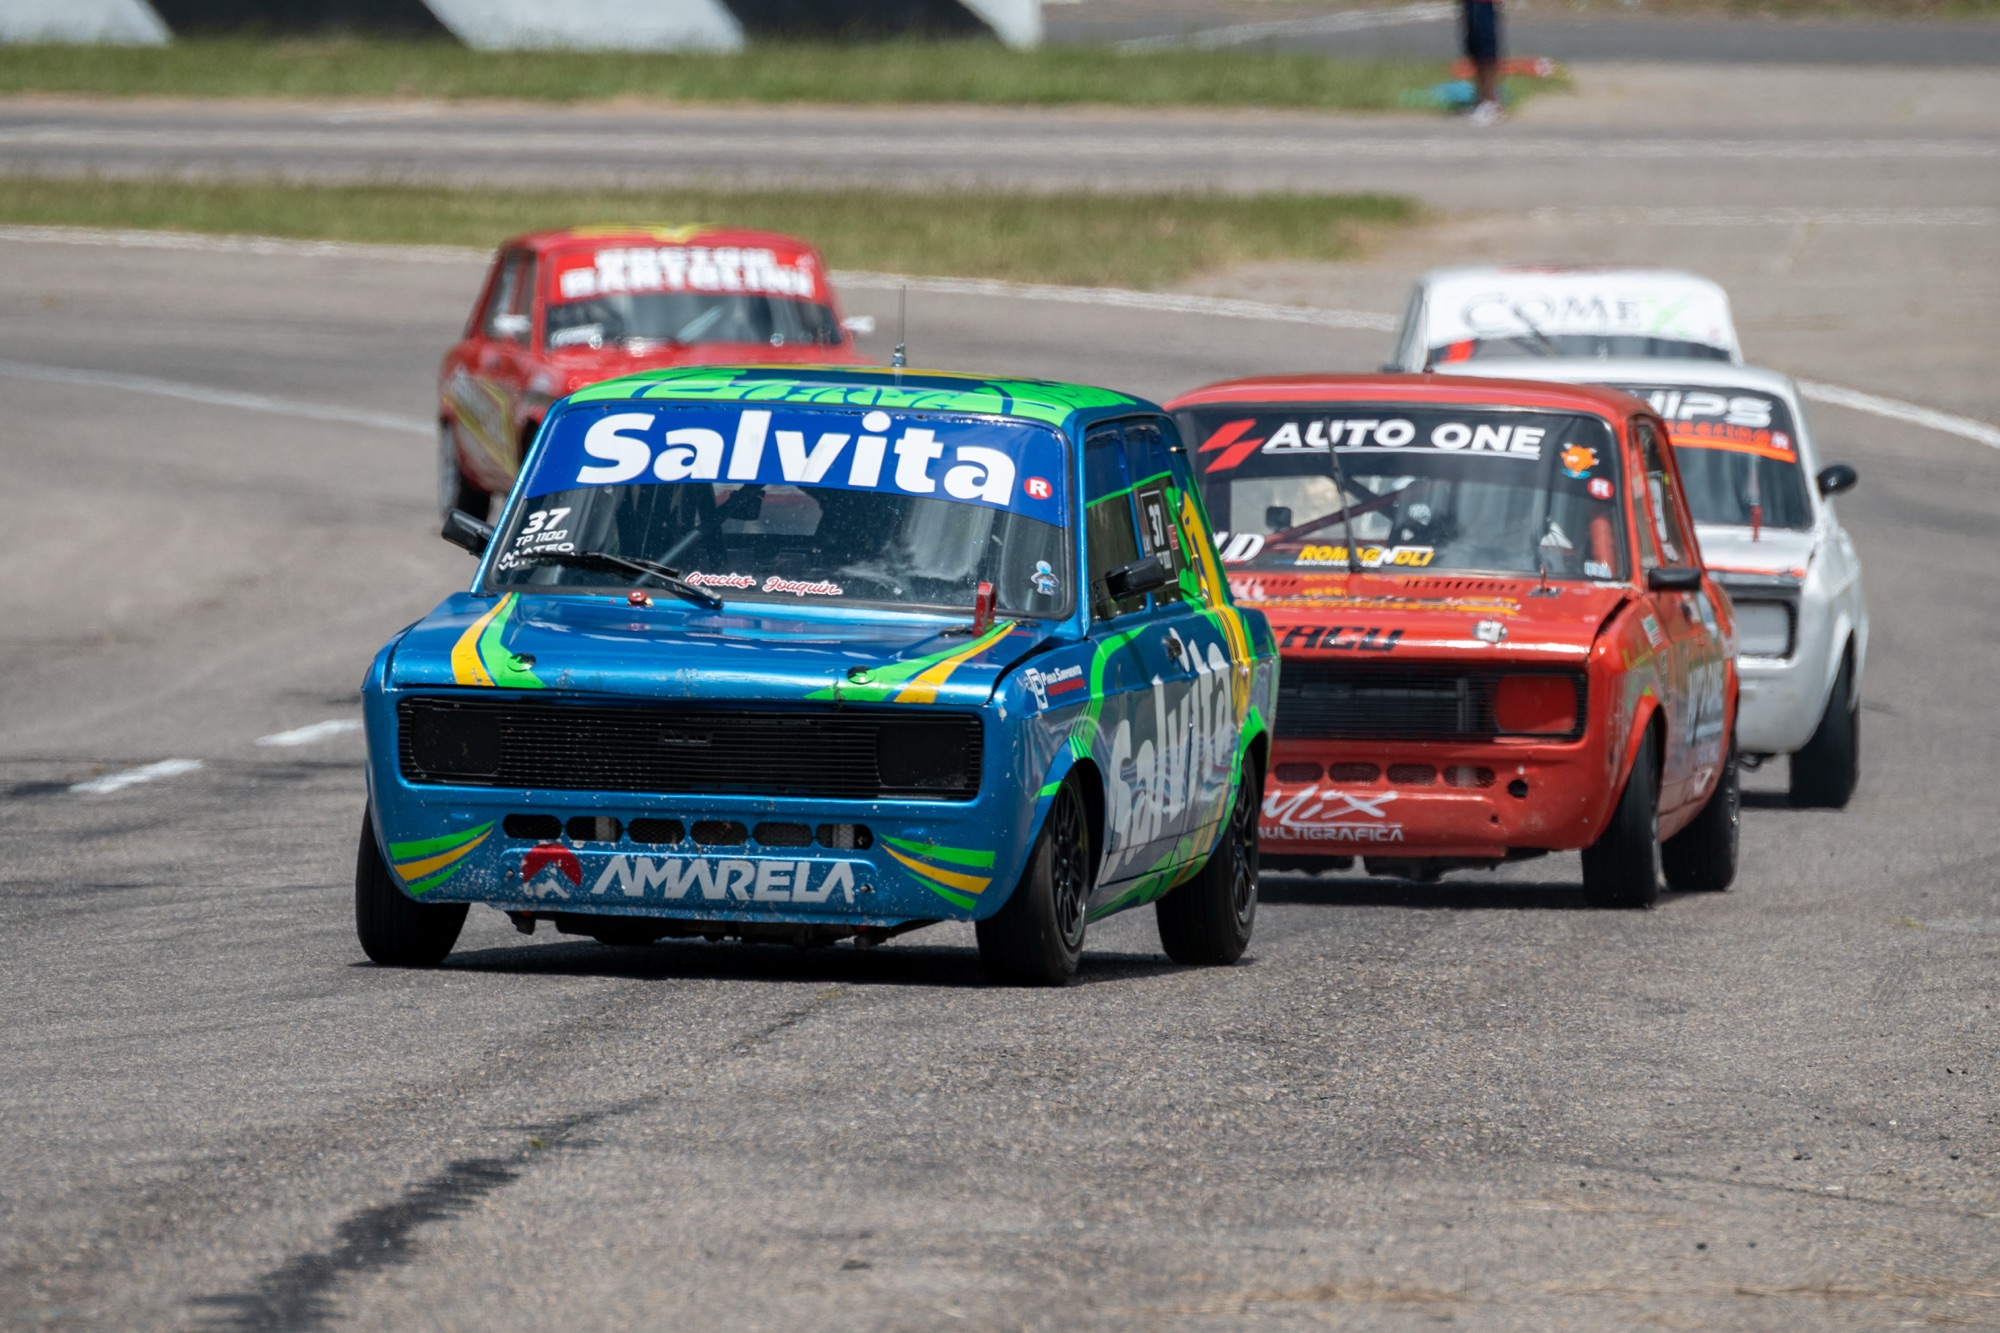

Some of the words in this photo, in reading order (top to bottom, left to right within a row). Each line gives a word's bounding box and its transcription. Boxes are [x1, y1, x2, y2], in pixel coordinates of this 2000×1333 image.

[1262, 418, 1416, 449] AUTO
[1430, 423, 1546, 454] ONE
[576, 410, 1016, 506] Salvita
[1029, 479, 1048, 497] R
[1591, 478, 1610, 497] R
[522, 507, 572, 535] 37
[1148, 503, 1165, 548] 37
[500, 542, 575, 563] MATEO
[515, 534, 534, 547] TP
[535, 530, 568, 543] 1100
[685, 571, 757, 589] Gracias
[1098, 627, 1232, 886] Salvita
[590, 854, 856, 904] AMARELA
